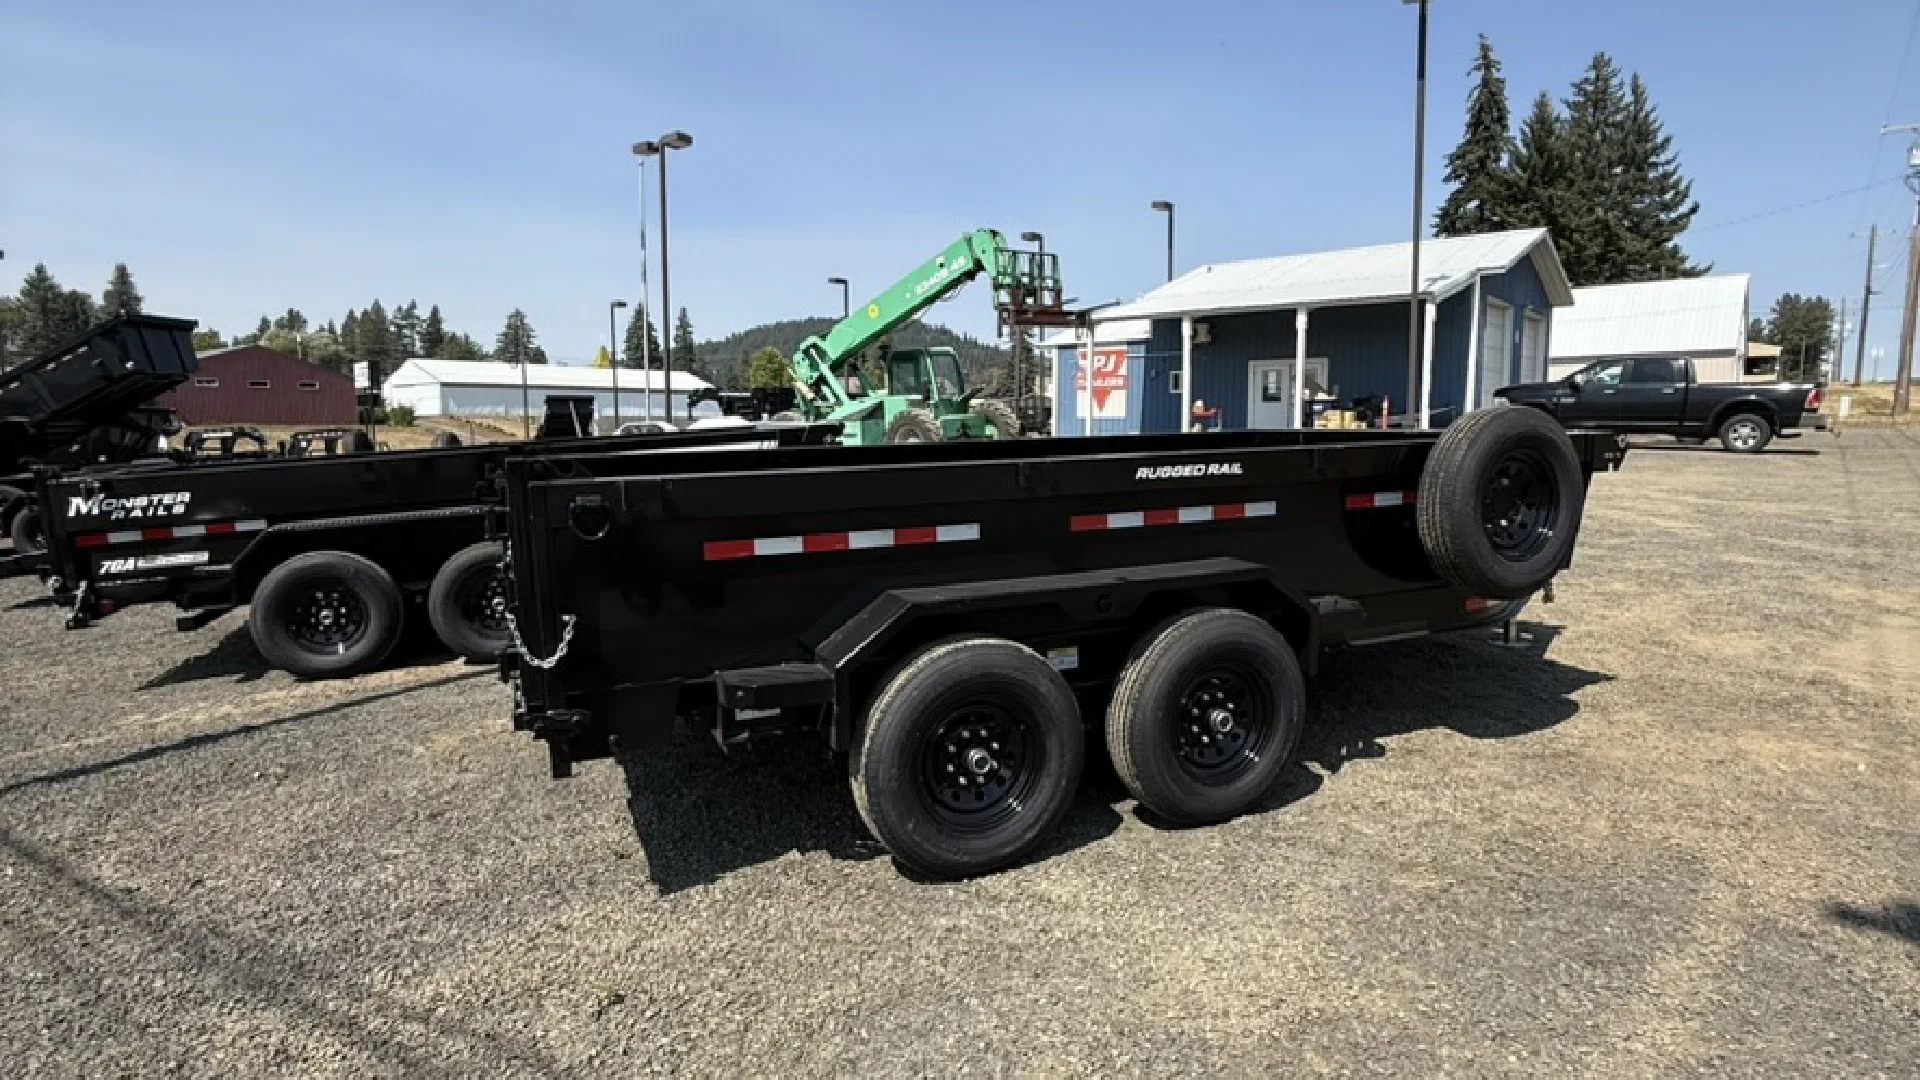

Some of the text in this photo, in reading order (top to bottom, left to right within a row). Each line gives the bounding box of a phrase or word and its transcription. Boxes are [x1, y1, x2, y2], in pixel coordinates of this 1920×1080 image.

[1136, 462, 1243, 480] RUGGED RAIL
[111, 504, 185, 520] RAILS
